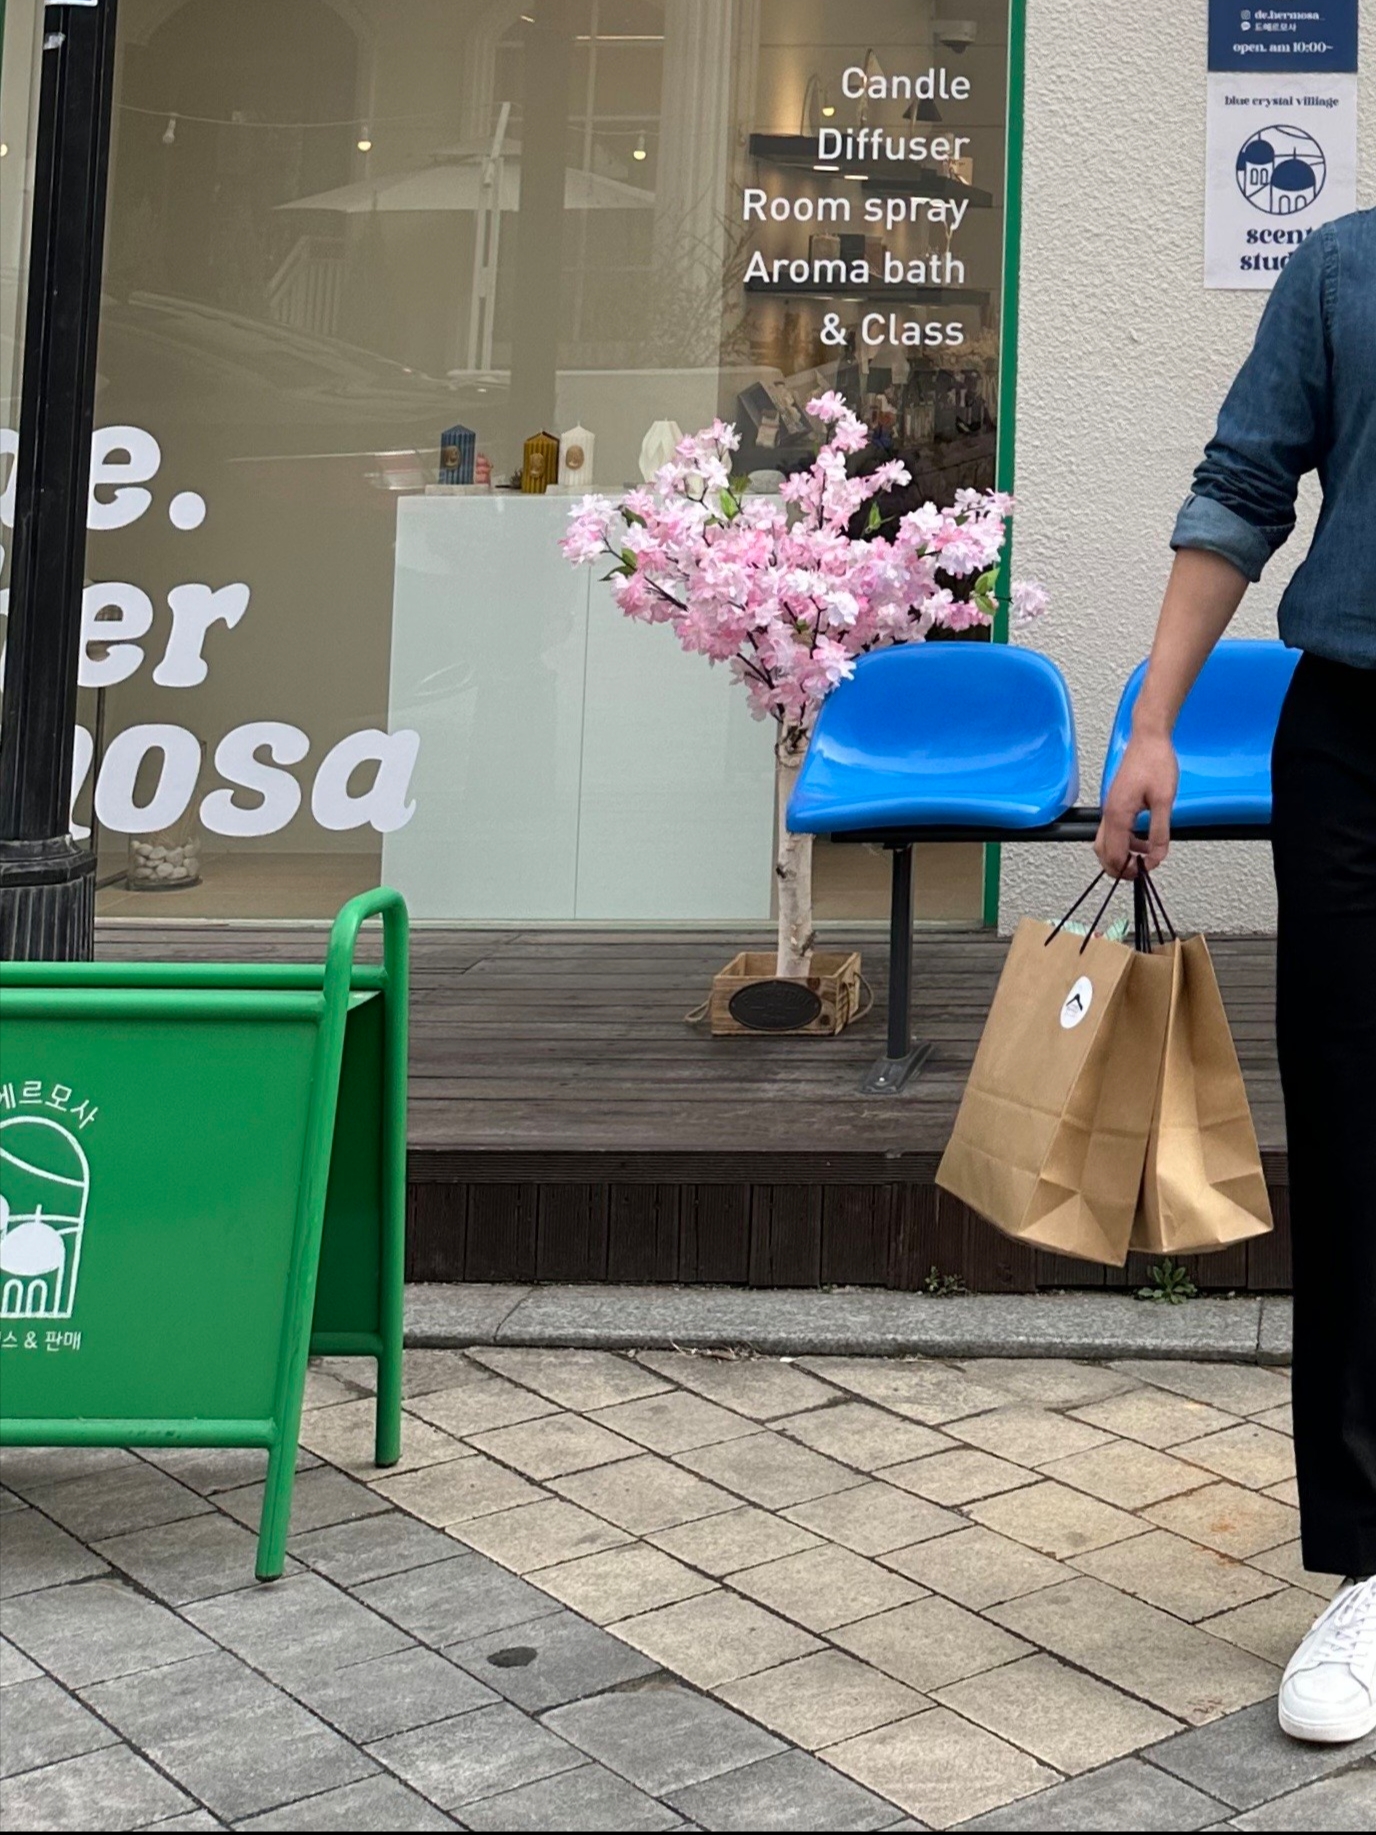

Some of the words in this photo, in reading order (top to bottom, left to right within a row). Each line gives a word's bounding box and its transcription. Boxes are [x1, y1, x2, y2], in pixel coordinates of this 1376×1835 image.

[1232, 43, 1267, 55] open.
[1269, 43, 1291, 53] am
[1292, 41, 1334, 53] 10:00~
[841, 67, 971, 100] Candle
[1224, 95, 1250, 106] blue
[1252, 95, 1293, 108] crystal
[817, 127, 971, 161] Diffuser
[743, 188, 850, 221] Room
[864, 196, 969, 230] spray
[743, 251, 870, 284] Aroma
[884, 251, 966, 284] bath
[819, 312, 848, 346] &
[861, 313, 965, 346] Class
[0, 581, 250, 688] er
[70, 721, 421, 838] osa
[24, 1330, 38, 1349] &
[45, 1330, 82, 1352] 판매
